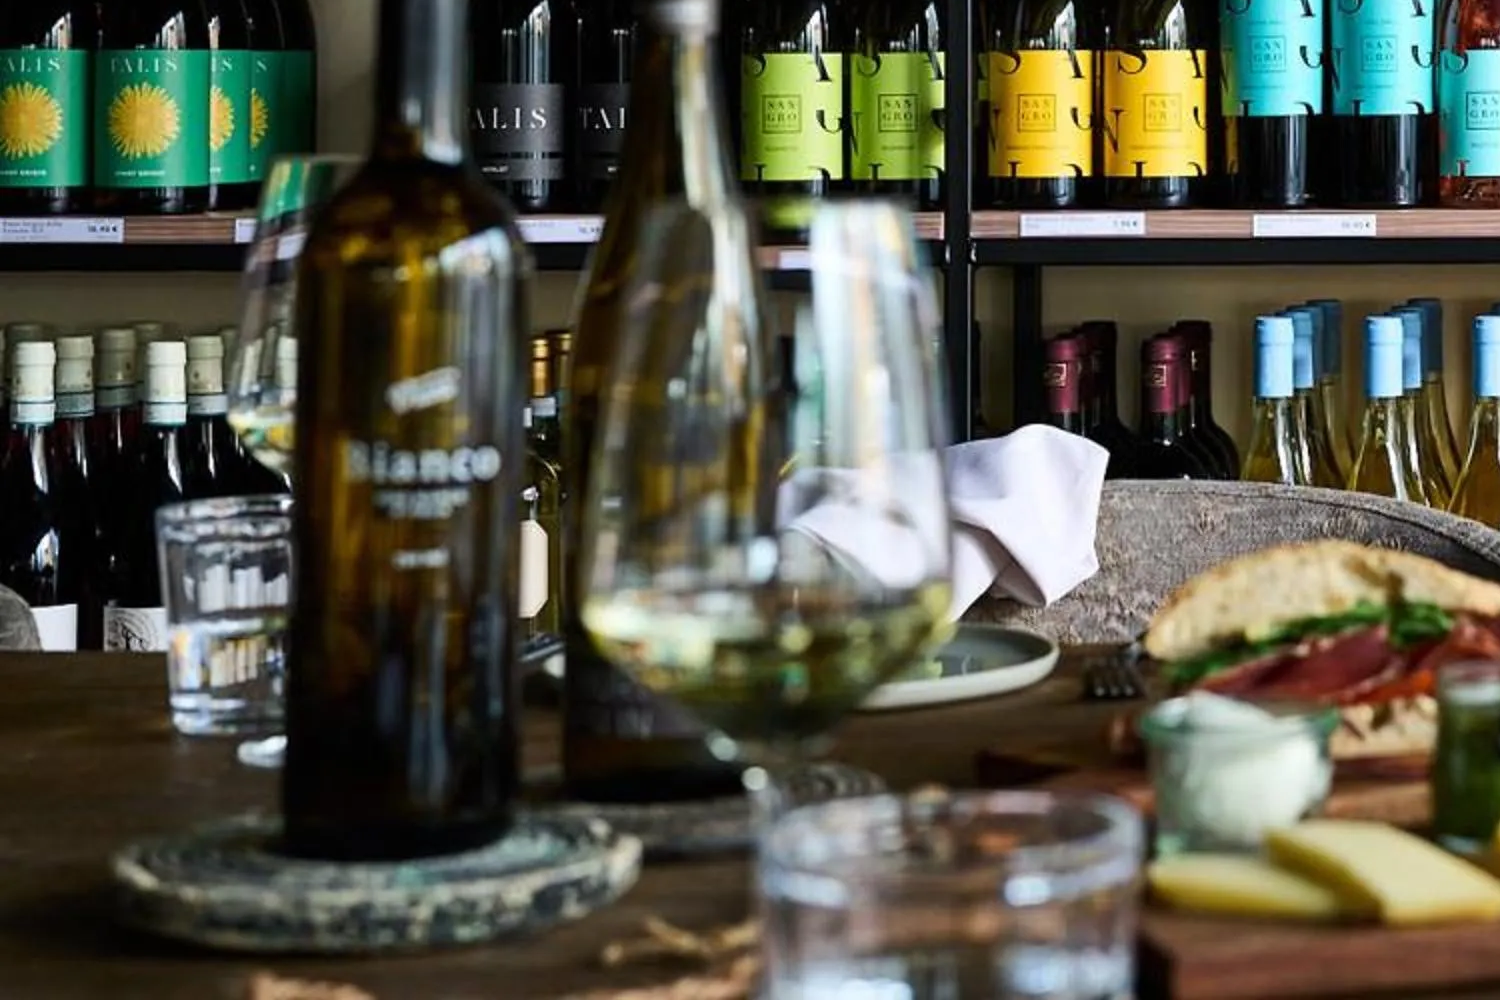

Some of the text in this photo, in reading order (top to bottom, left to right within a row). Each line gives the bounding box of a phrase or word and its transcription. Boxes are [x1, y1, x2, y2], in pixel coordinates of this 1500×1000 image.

[0, 57, 61, 73] ALIS
[110, 57, 178, 73] TALIS
[470, 106, 547, 129] ALIS
